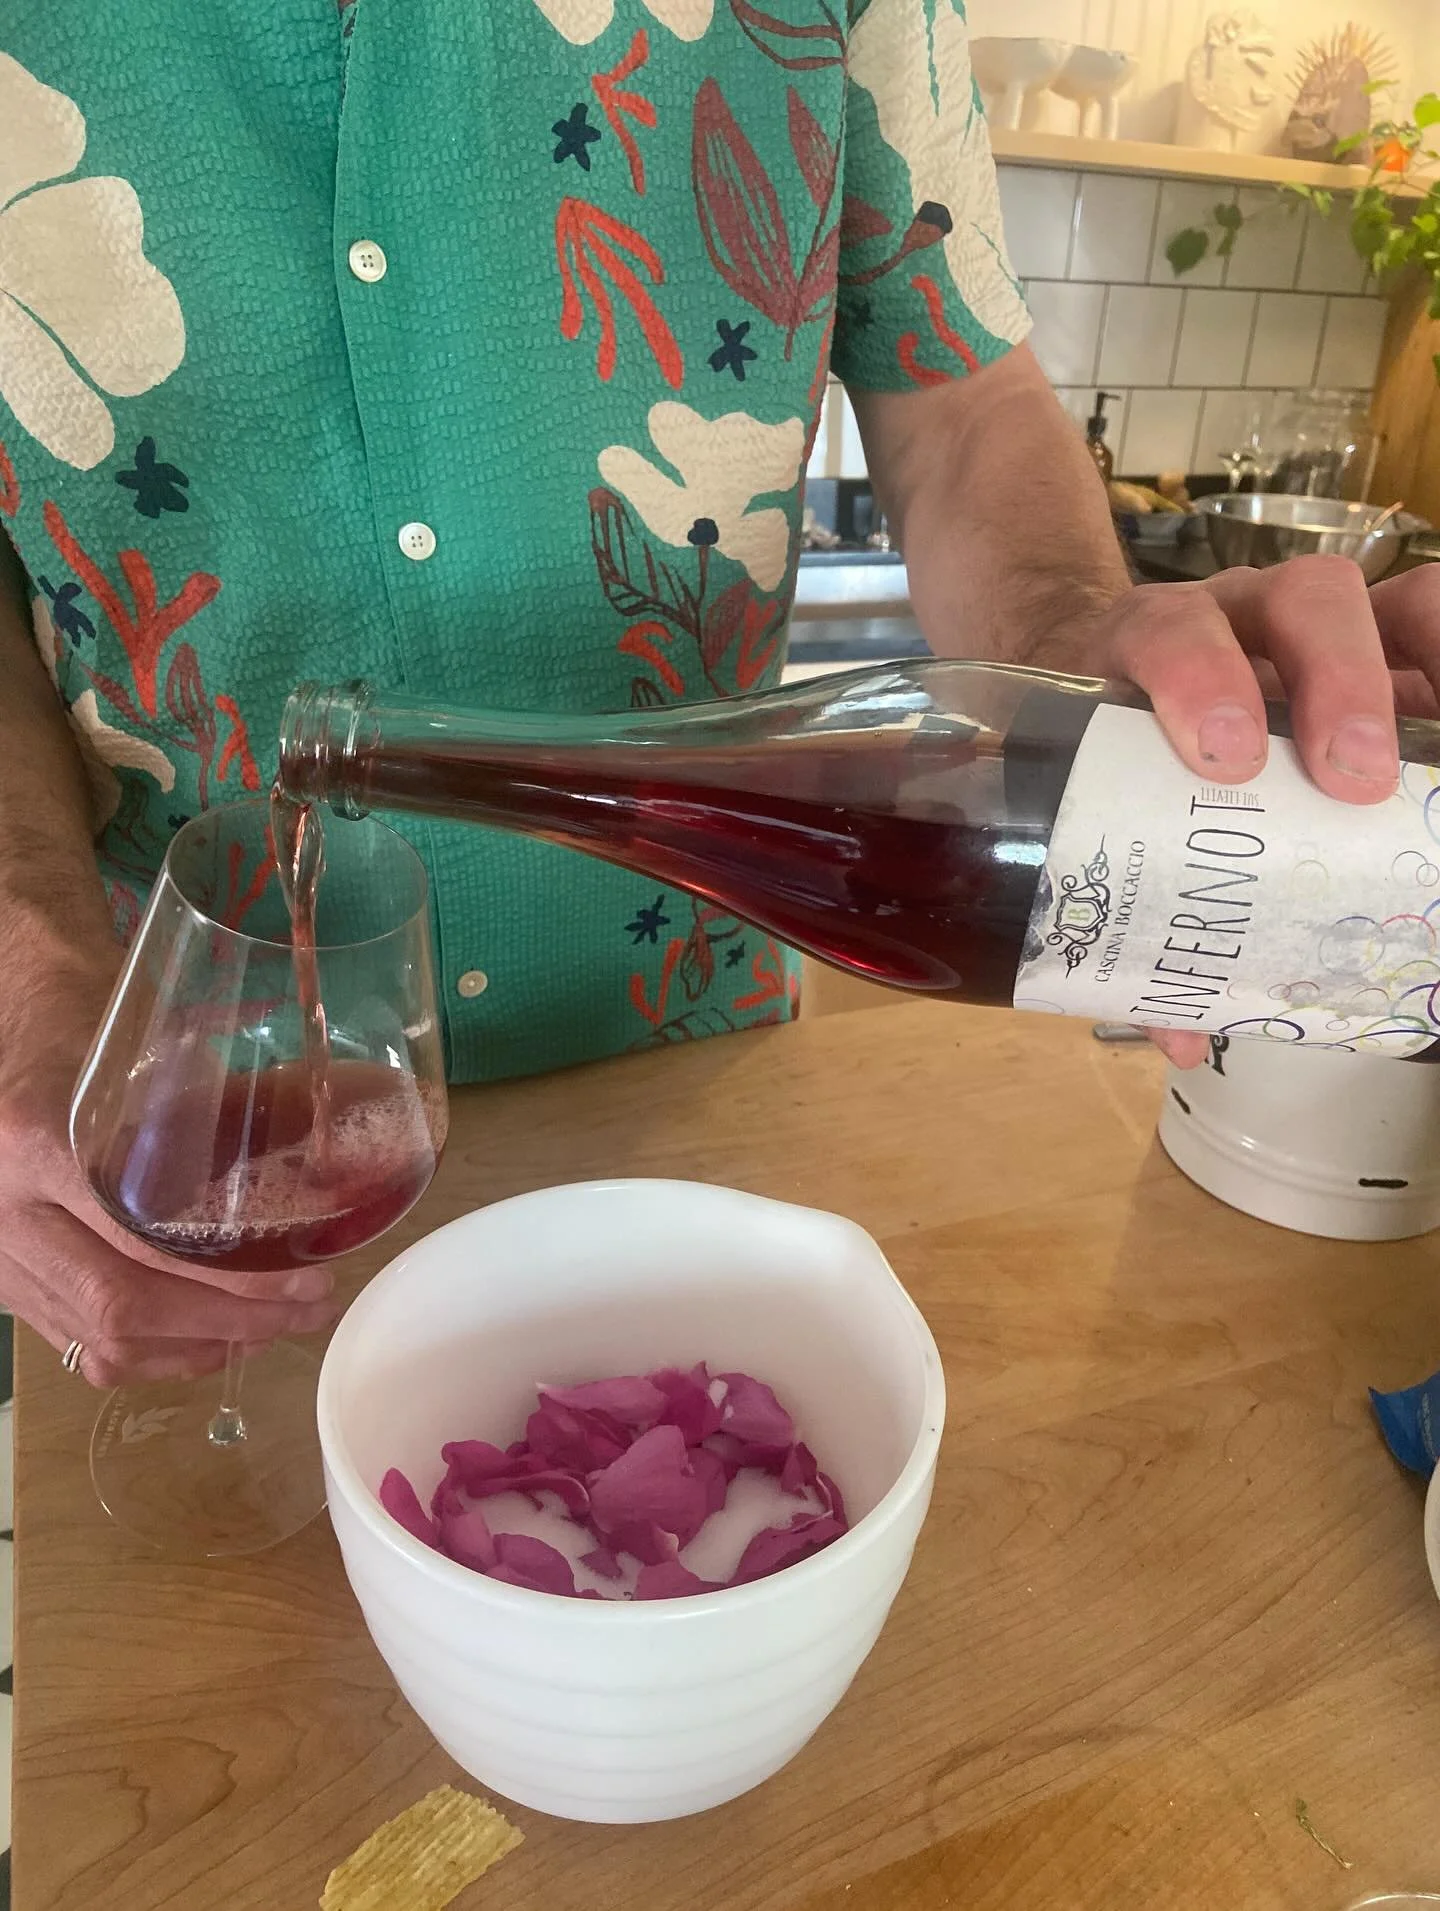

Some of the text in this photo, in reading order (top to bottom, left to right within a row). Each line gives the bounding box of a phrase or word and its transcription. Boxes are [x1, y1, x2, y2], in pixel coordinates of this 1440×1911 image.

[1068, 908, 1091, 921] B
[1095, 840, 1146, 983] CASCINA BOCCACCIO
[1130, 795, 1266, 1021] INFERNOT
